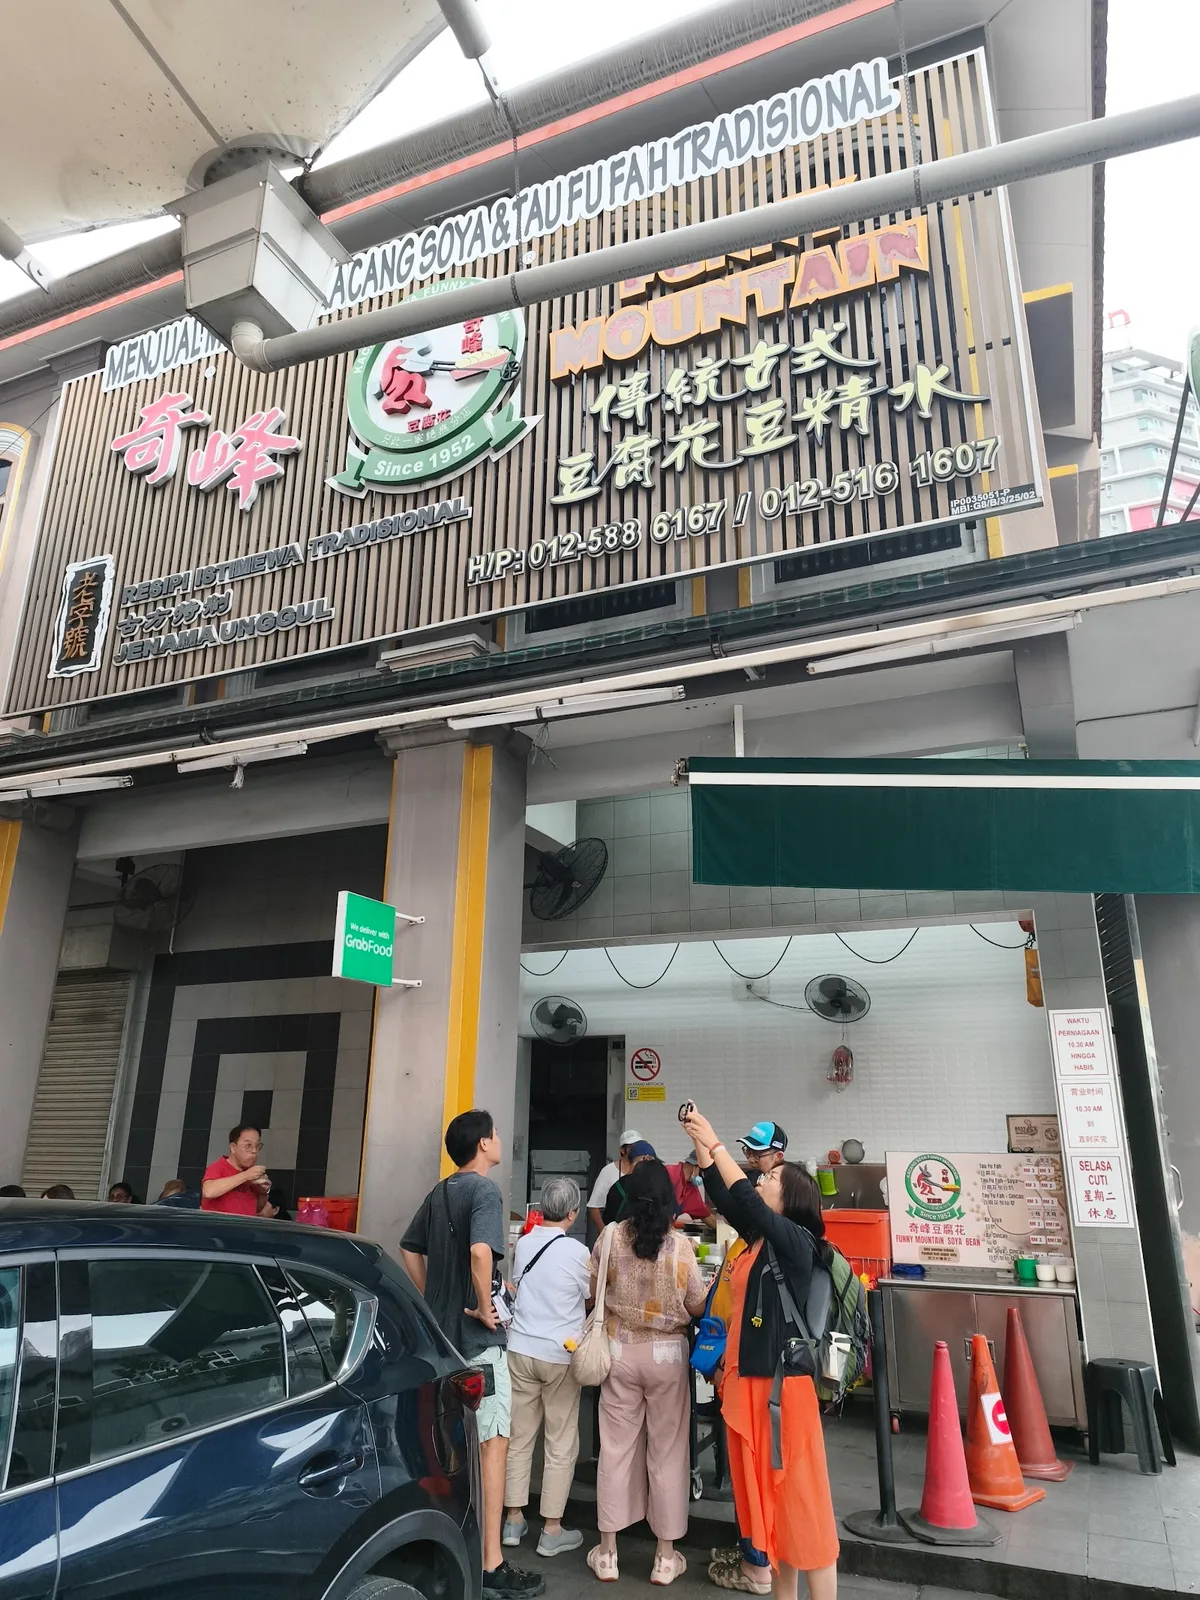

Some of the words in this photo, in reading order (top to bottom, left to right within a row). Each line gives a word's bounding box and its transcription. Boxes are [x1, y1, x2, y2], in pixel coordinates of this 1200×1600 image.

[106, 319, 201, 388] MENJUAL
[323, 238, 415, 309] ACANG
[419, 211, 486, 275] SOYA
[491, 201, 510, 249] &
[609, 141, 668, 206] FAH
[673, 62, 893, 181] TRADISIONAL
[549, 215, 929, 384] MOUNTAIN
[590, 322, 881, 432] 傳統古式
[407, 409, 452, 433] 豆腐花
[111, 392, 302, 512] 奇峰
[374, 459, 424, 477] Since
[429, 435, 475, 468] 1952
[950, 488, 1011, 508] IP0035051-P
[467, 548, 525, 586] H/P:
[528, 518, 642, 570] 012-588
[650, 498, 727, 544] 6167
[759, 460, 899, 520] 012-516
[909, 435, 1000, 488] 1607
[121, 571, 190, 606] RESIPI
[195, 543, 302, 588] ISTIMEWA
[308, 499, 471, 559] TRADISIONAL
[61, 571, 99, 661] 老字號
[113, 625, 218, 665] JENAMA
[220, 598, 333, 642] UNGGUL
[350, 922, 359, 931] We
[359, 925, 377, 936] deliver
[378, 931, 390, 940] with
[345, 933, 393, 957] GrabFood
[1058, 1029, 1100, 1037] PERNIAGAAN
[1078, 1160, 1113, 1172] SELASA
[1088, 1174, 1109, 1186] CUTI
[1084, 1189, 1117, 1203] 星期二
[1088, 1207, 1117, 1220] 休息
[896, 1234, 913, 1243] FUNNY
[914, 1235, 945, 1245] MOUNTAIN
[947, 1237, 963, 1246] SOYA
[965, 1238, 981, 1246] BEAN
[908, 1222, 966, 1236] 奇峰豆腐花
